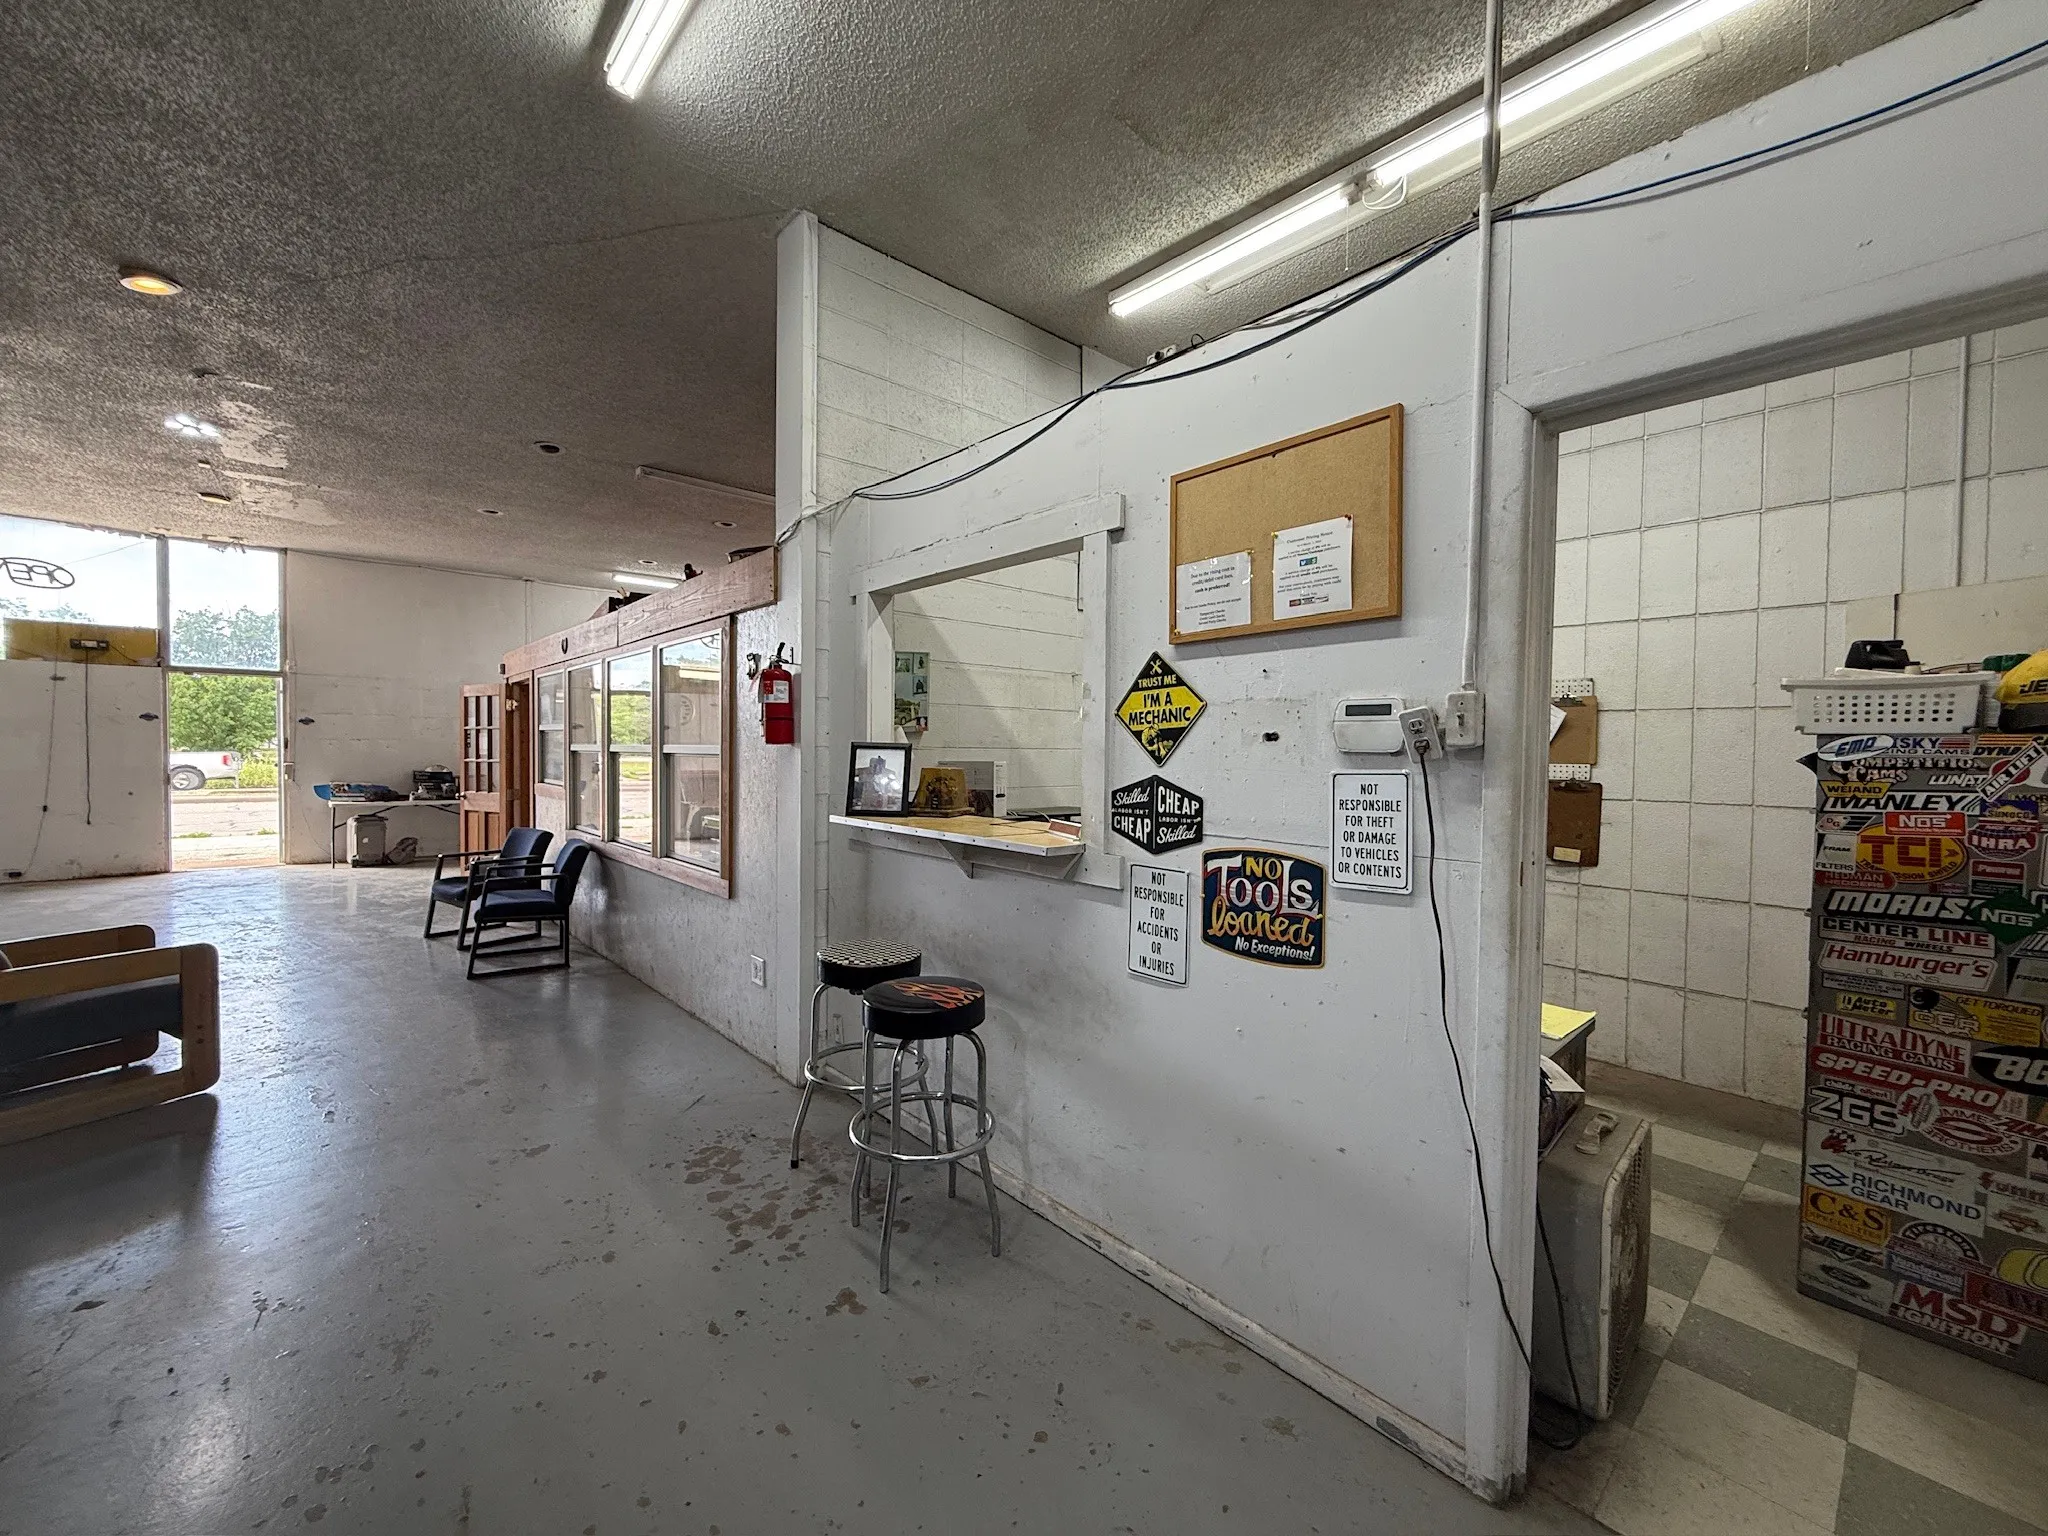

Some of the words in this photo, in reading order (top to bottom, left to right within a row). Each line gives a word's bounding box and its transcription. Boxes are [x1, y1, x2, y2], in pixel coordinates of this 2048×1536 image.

[1138, 676, 1162, 688] TRUST
[1164, 674, 1177, 685] ME
[1144, 692, 1161, 708] I'M
[1164, 692, 1172, 706] A
[1128, 706, 1191, 726] MECHANIC
[1114, 786, 1150, 806] Skilled
[1360, 784, 1379, 796] NOT
[1827, 785, 1882, 794] WEIAND
[1158, 785, 1200, 816] CHEAP
[1338, 799, 1402, 812] RESPONSIBLE
[1829, 794, 1969, 811] MANLEY
[1114, 816, 1152, 844] CHEAP
[1345, 816, 1363, 827] FOR
[1366, 816, 1394, 828] THEFT
[1899, 815, 1950, 828] NOS
[1156, 824, 1197, 844] Skilled
[1343, 830, 1356, 843] OR
[1358, 832, 1396, 845] DAMAGE
[1972, 834, 2032, 850] IHRA
[1340, 846, 1352, 858] TO
[1354, 847, 1400, 862] VEHICLES
[1860, 835, 1942, 868] TCI
[1246, 856, 1282, 880] NO
[1338, 862, 1350, 874] OR
[1353, 863, 1402, 879] CONTENTS
[1815, 862, 1854, 872] FILTERS
[1152, 872, 1166, 886] NOT
[1134, 886, 1184, 908] RESPONSIBLE
[1150, 906, 1165, 920] FOR
[1206, 894, 1315, 947] loaned
[1980, 908, 2036, 928] NOS
[1136, 920, 1179, 942] ACCIDENTS
[1823, 918, 1918, 939] CENTER
[1928, 928, 1989, 946] LINE
[1152, 941, 1162, 956] OR
[1234, 936, 1250, 951] No
[1250, 938, 1316, 961] Exceptions!
[1139, 954, 1175, 976] INJURIES
[1826, 944, 1990, 978] Hamburger's
[1826, 1035, 1894, 1058] RACING
[1902, 1052, 1956, 1072] CAMS
[1815, 1052, 1999, 1108] SPEED-PRO
[1852, 1172, 1982, 1220] RICHMOND
[1852, 1186, 1908, 1211] GEAR
[1900, 1282, 2019, 1338] MSD
